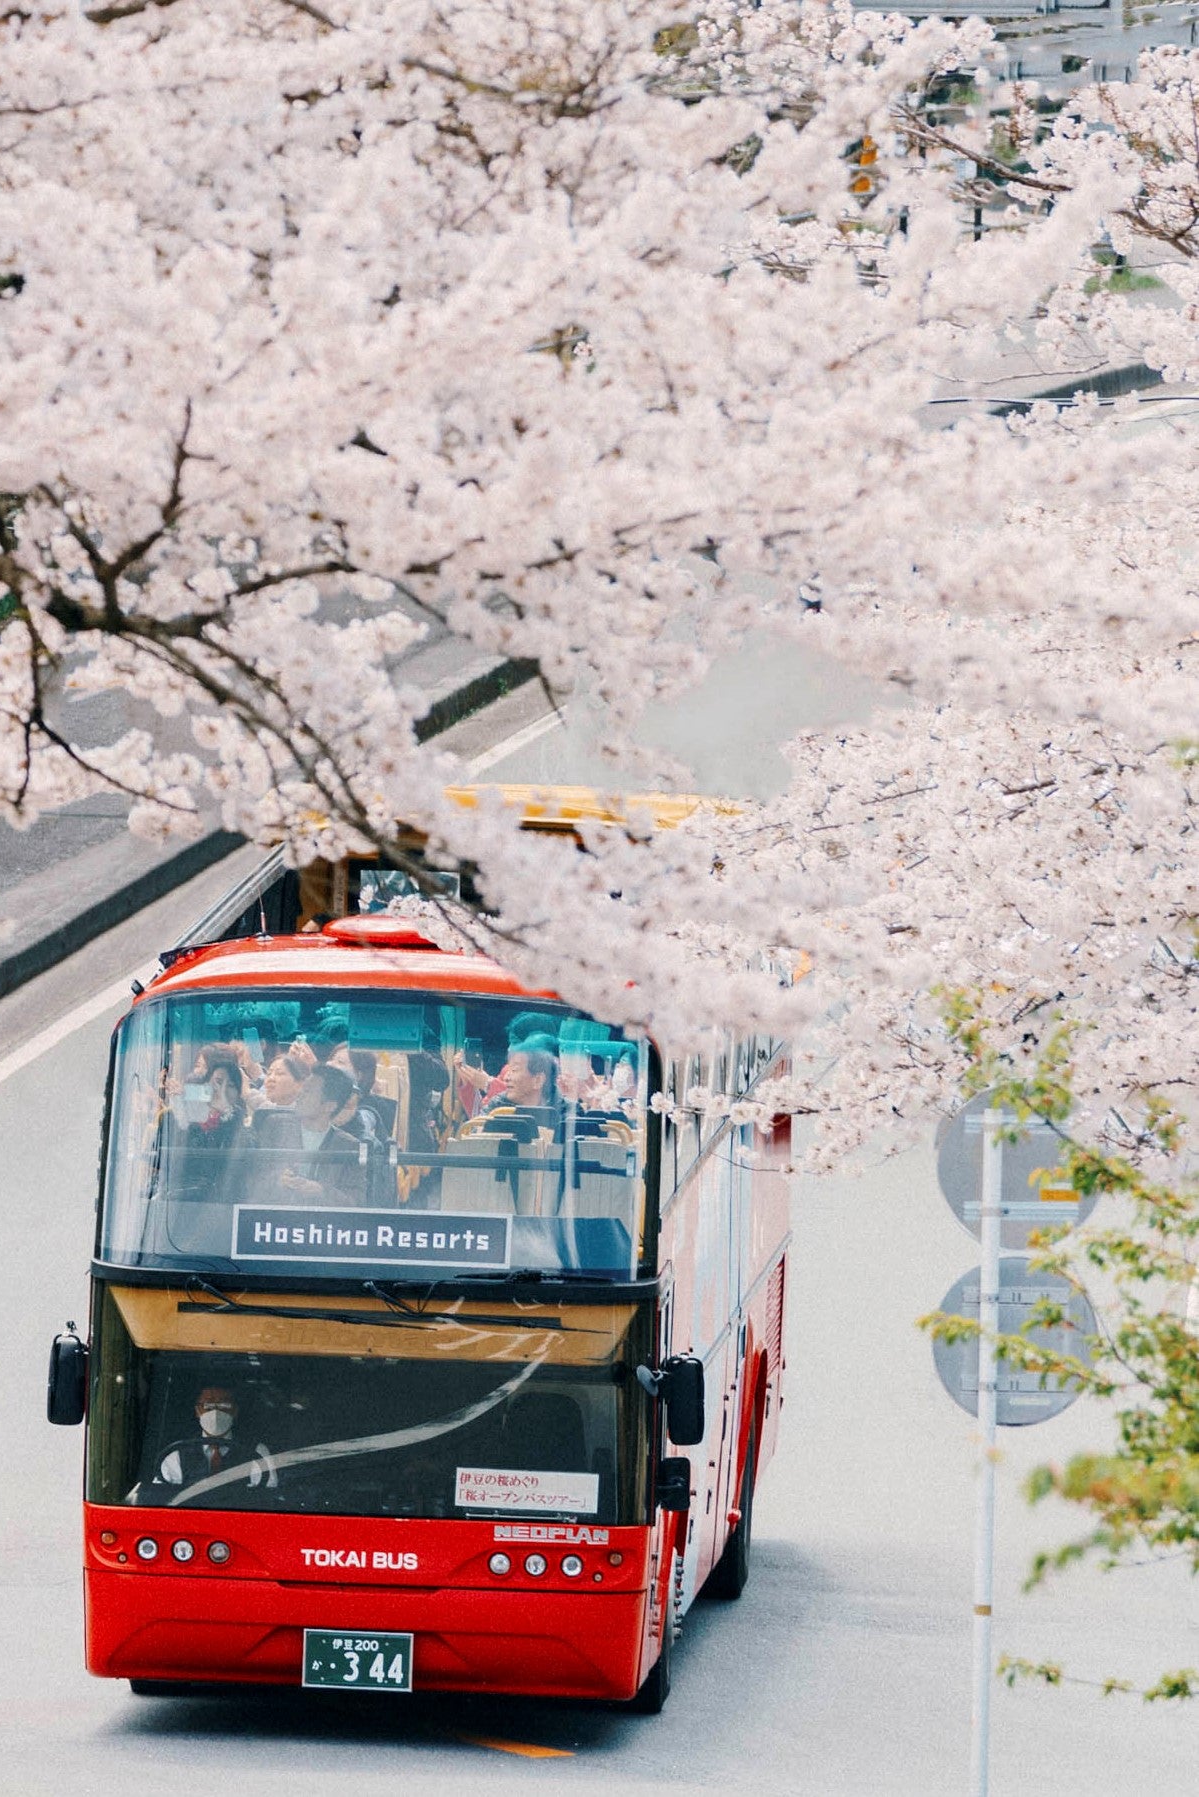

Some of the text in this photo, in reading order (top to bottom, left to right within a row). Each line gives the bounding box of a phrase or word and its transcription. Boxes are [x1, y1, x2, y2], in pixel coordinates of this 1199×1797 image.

[254, 1222, 489, 1250] Hoshino Resorts
[460, 1472, 539, 1488] 伊豆の桜めぐり
[494, 1525, 609, 1545] NEOPLAN
[300, 1549, 418, 1570] TOKAI BUS
